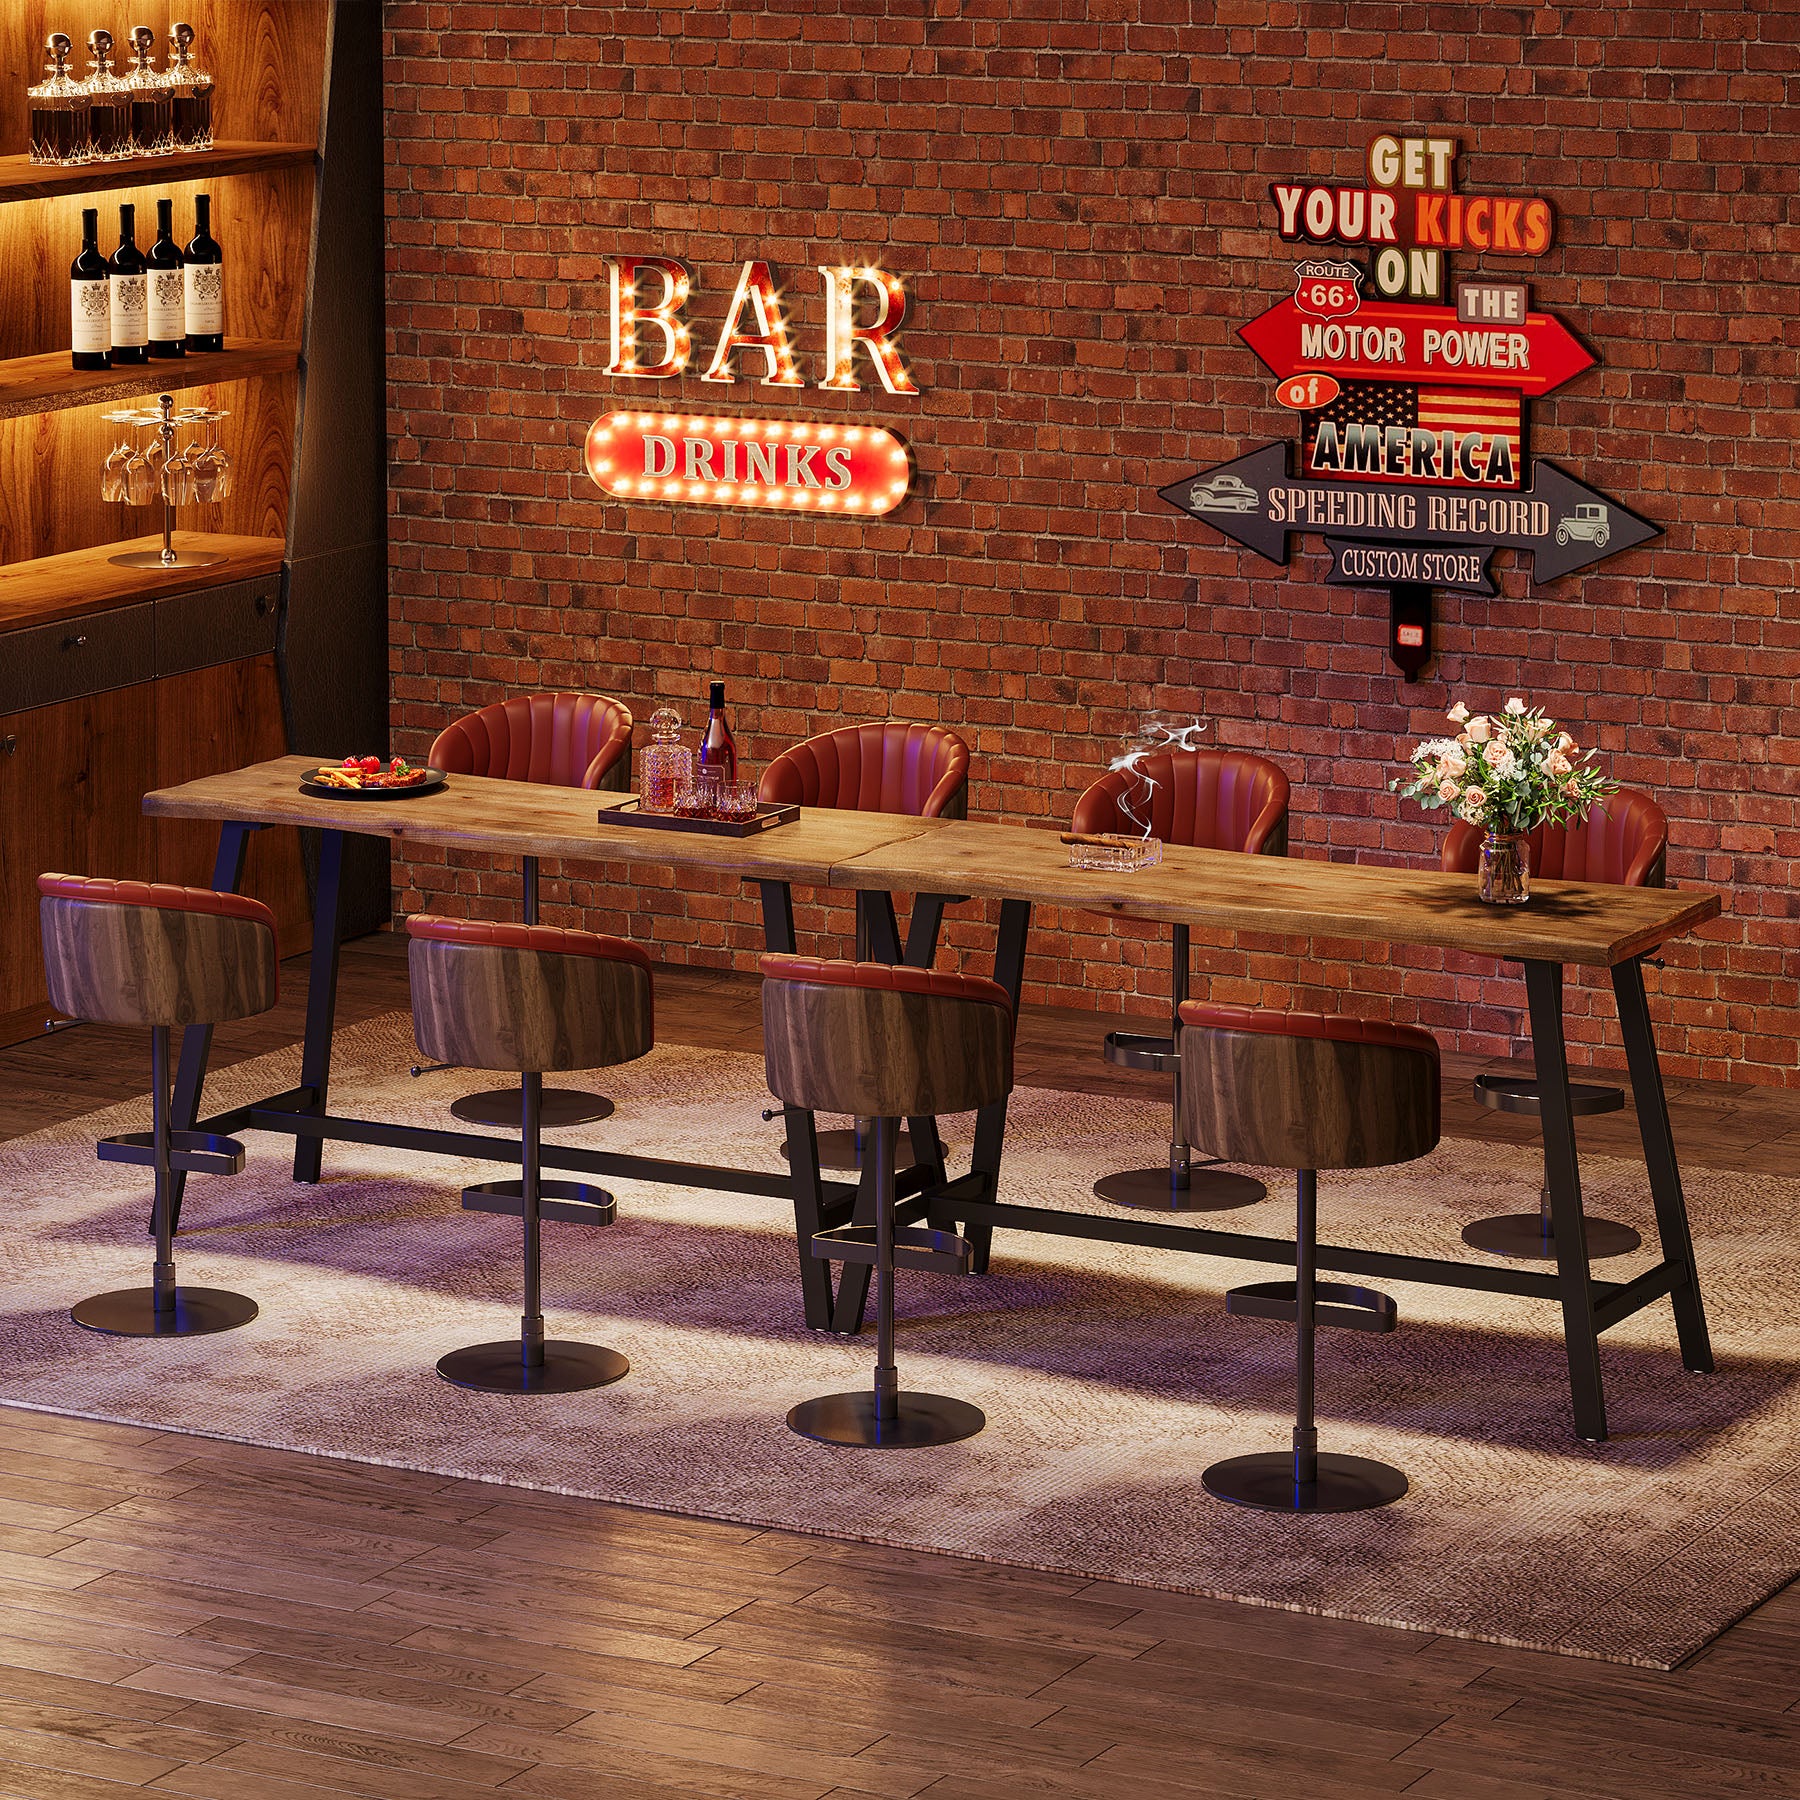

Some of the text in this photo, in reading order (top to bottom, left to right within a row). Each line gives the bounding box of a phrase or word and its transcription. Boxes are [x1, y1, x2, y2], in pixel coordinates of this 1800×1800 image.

[1370, 135, 1453, 189] GET
[1275, 185, 1550, 251] YOUR KICKS
[1306, 265, 1350, 278] ROUTE
[1310, 284, 1344, 307] 66
[1376, 249, 1440, 297] ON
[602, 254, 919, 395] BAR
[1464, 289, 1518, 318] THE
[1301, 324, 1529, 369] MOTOR POWER
[1289, 378, 1318, 404] of
[642, 434, 852, 490] DRINKS
[1311, 421, 1515, 485] AMERICA
[1268, 487, 1550, 536] SPEEDING RECORD
[1341, 550, 1480, 583] CUSTOM STORE
